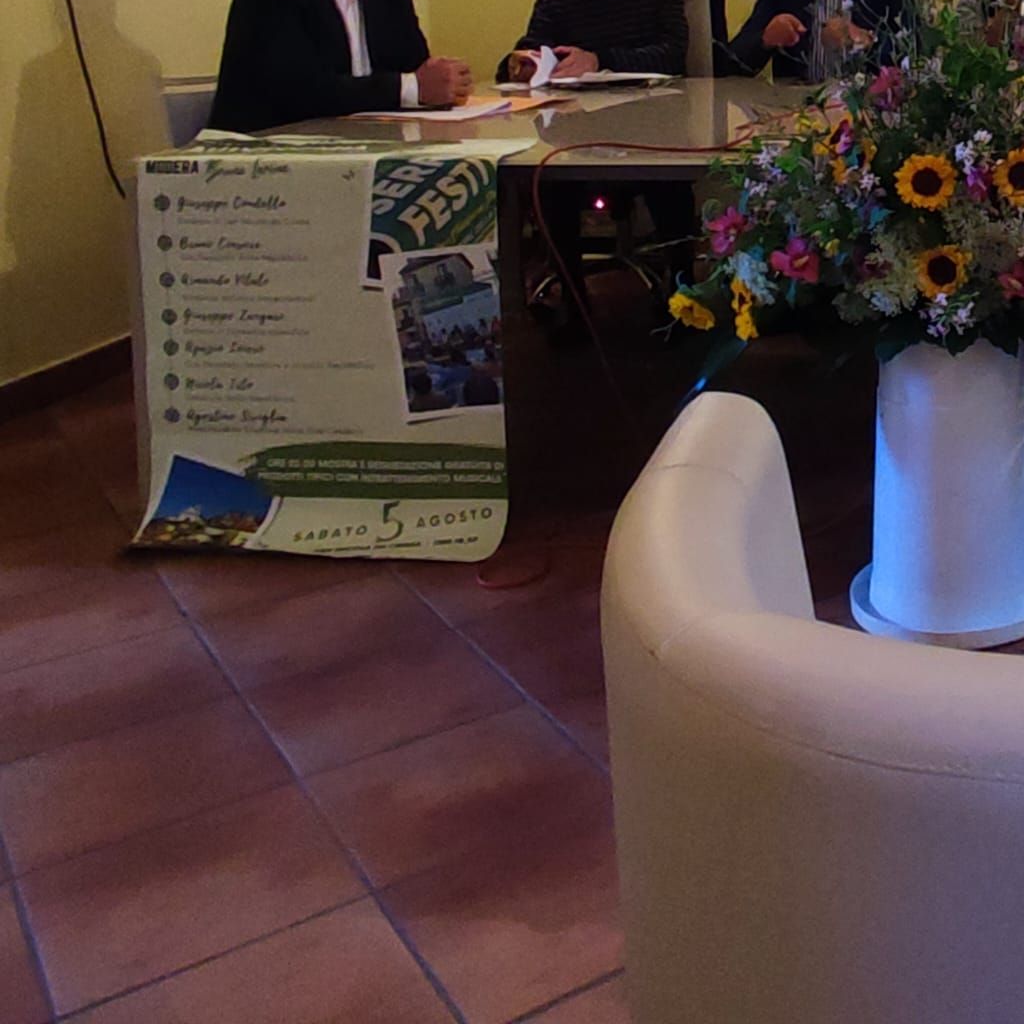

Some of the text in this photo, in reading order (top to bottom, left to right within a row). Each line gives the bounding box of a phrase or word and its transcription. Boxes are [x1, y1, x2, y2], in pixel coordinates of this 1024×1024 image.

[293, 501, 493, 543] SABATO 5 AGOSTO
